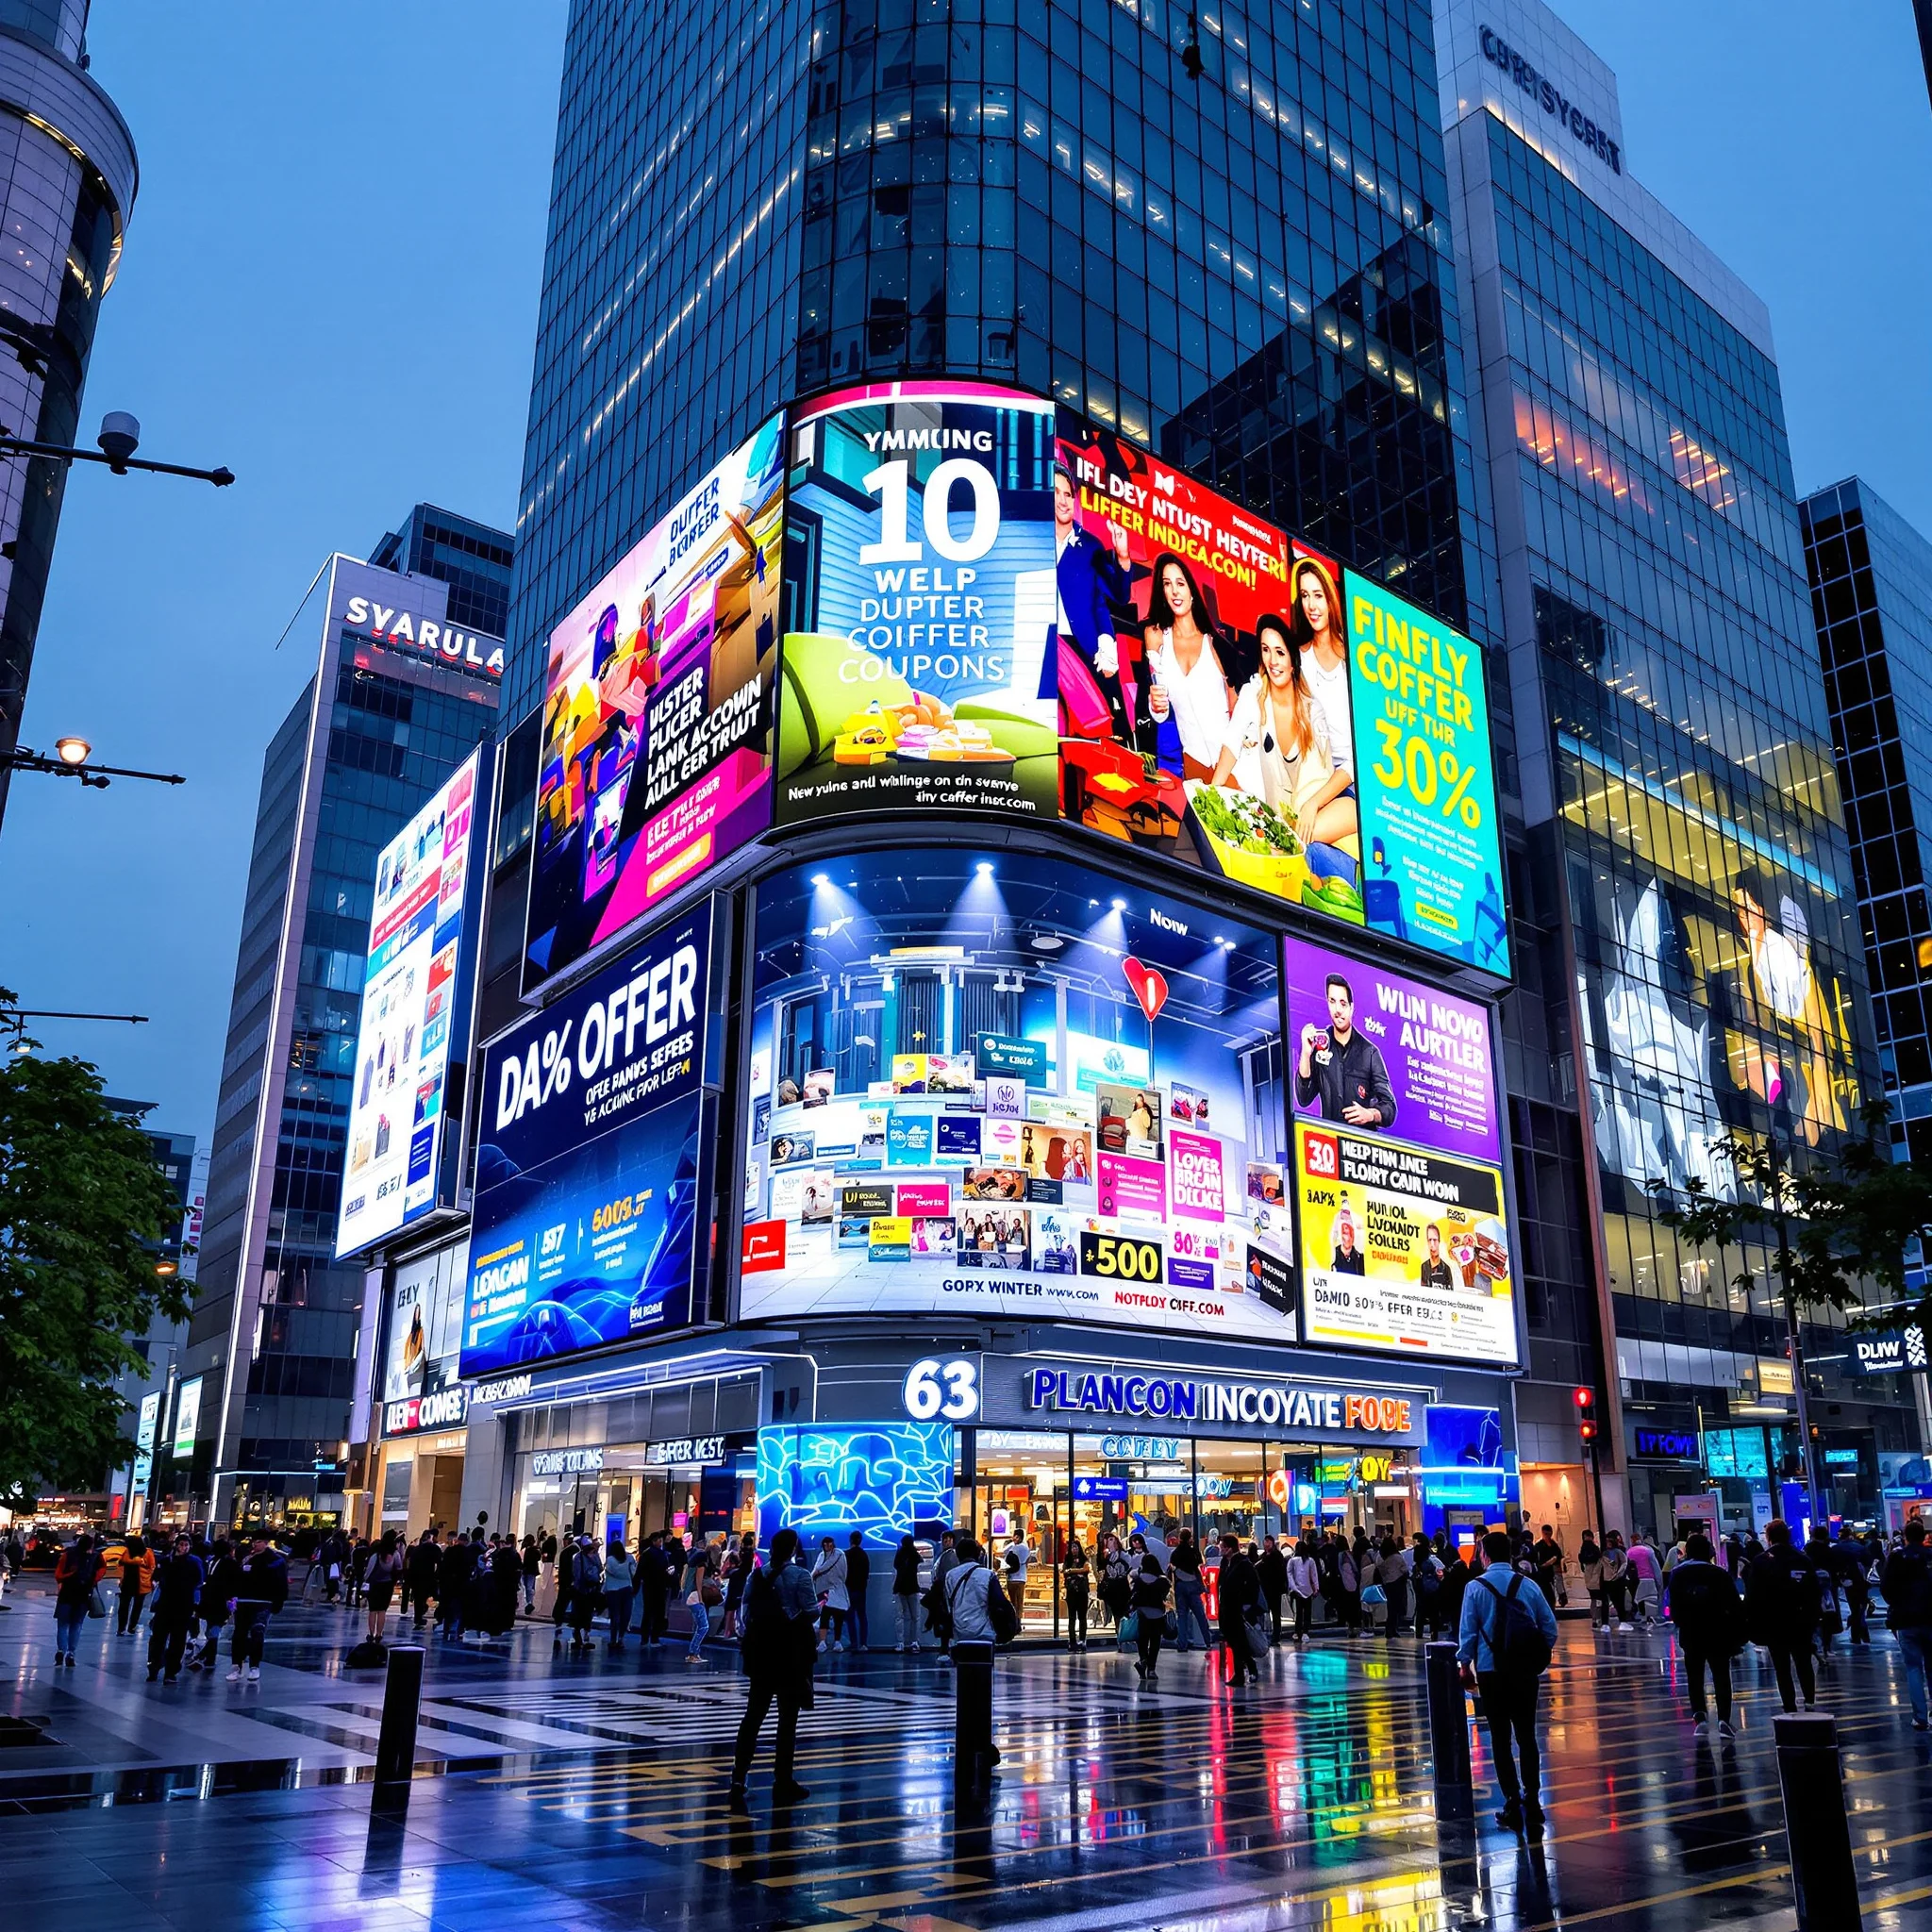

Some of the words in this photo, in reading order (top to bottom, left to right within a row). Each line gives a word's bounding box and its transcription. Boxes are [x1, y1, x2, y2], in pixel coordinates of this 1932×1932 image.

[858, 458, 1001, 565] 10
[1079, 486, 1143, 535] LIFFER
[1109, 473, 1148, 508] DEY
[1152, 496, 1212, 541] NTUST
[860, 595, 984, 622] DUPTER
[874, 568, 976, 593] WELP
[847, 624, 990, 651] COIFFER
[1353, 595, 1468, 688] FINFLY
[838, 654, 1005, 683] COUPONS
[1357, 641, 1474, 732] COFFER
[647, 732, 689, 786] LANK
[934, 776, 951, 787] on
[1372, 718, 1481, 829] 30%
[495, 1019, 574, 1133] DA%
[577, 944, 697, 1080] OFFER
[989, 1280, 1042, 1296] WINTER
[903, 1358, 979, 1420] 63
[1031, 1368, 1197, 1419] PLANCON
[1202, 1383, 1341, 1428] INCOYATE
